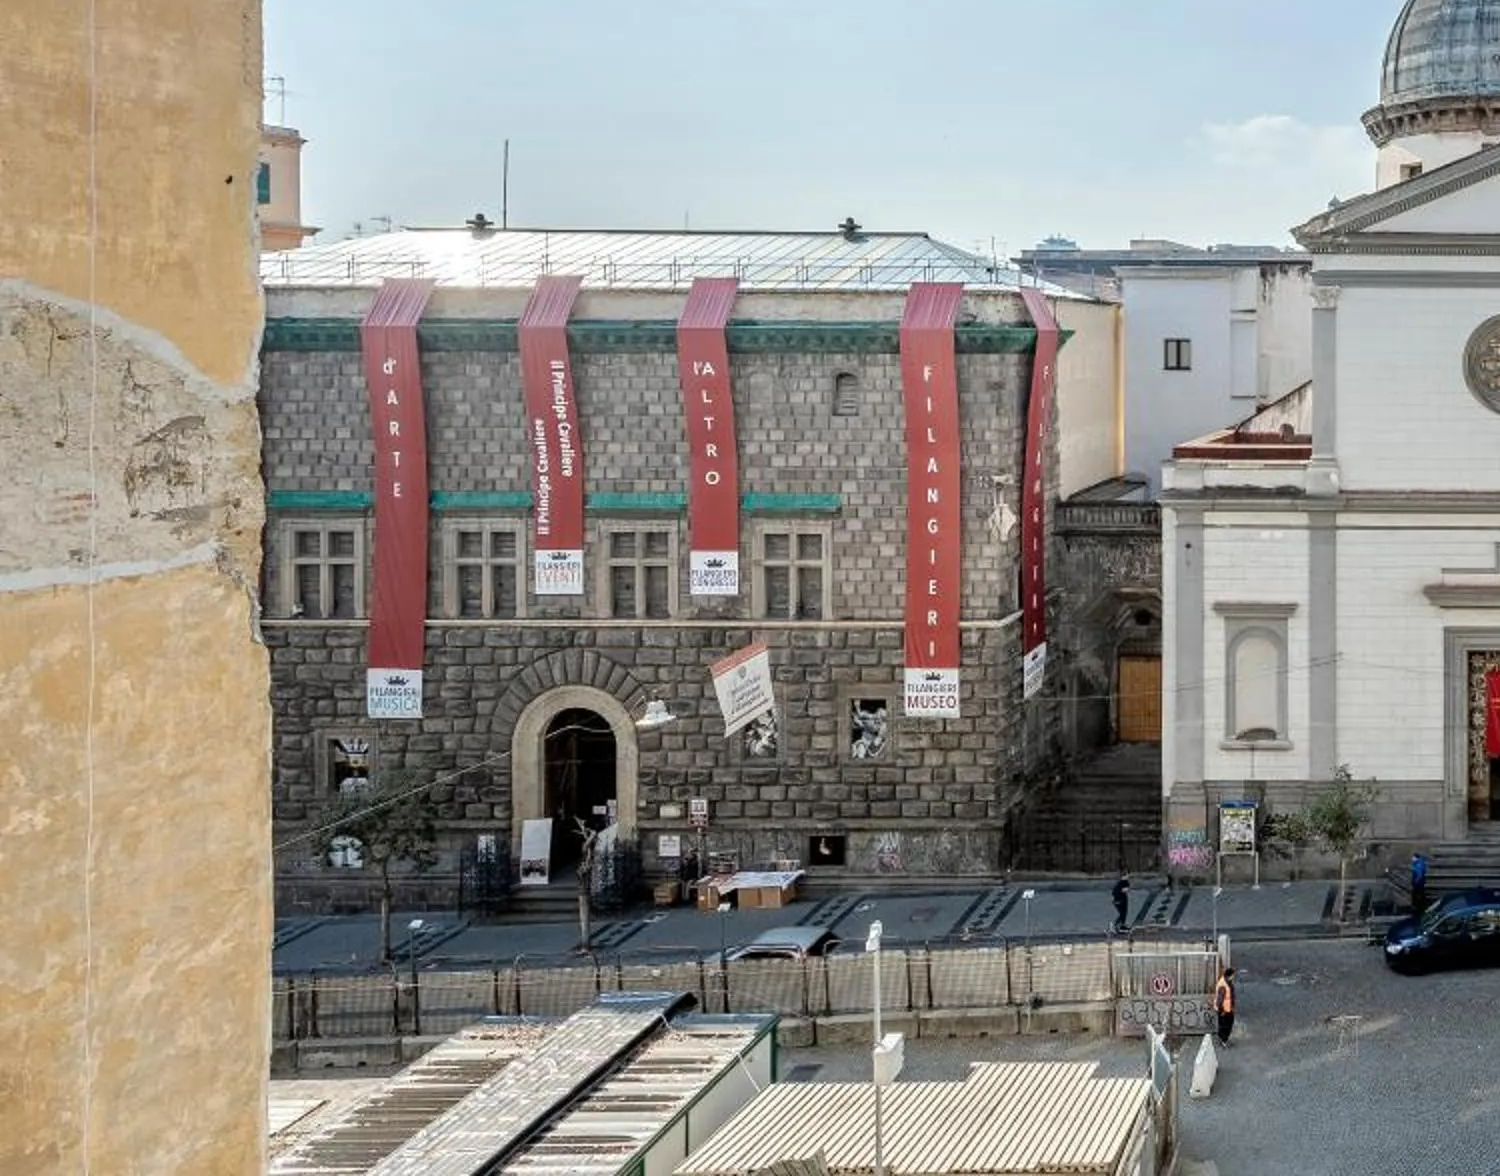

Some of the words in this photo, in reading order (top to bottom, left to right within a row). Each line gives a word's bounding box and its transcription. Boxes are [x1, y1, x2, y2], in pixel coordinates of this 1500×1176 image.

[536, 475, 552, 524] Principe
[922, 366, 939, 657] FILANGIERI
[907, 695, 957, 709] MUSEO
